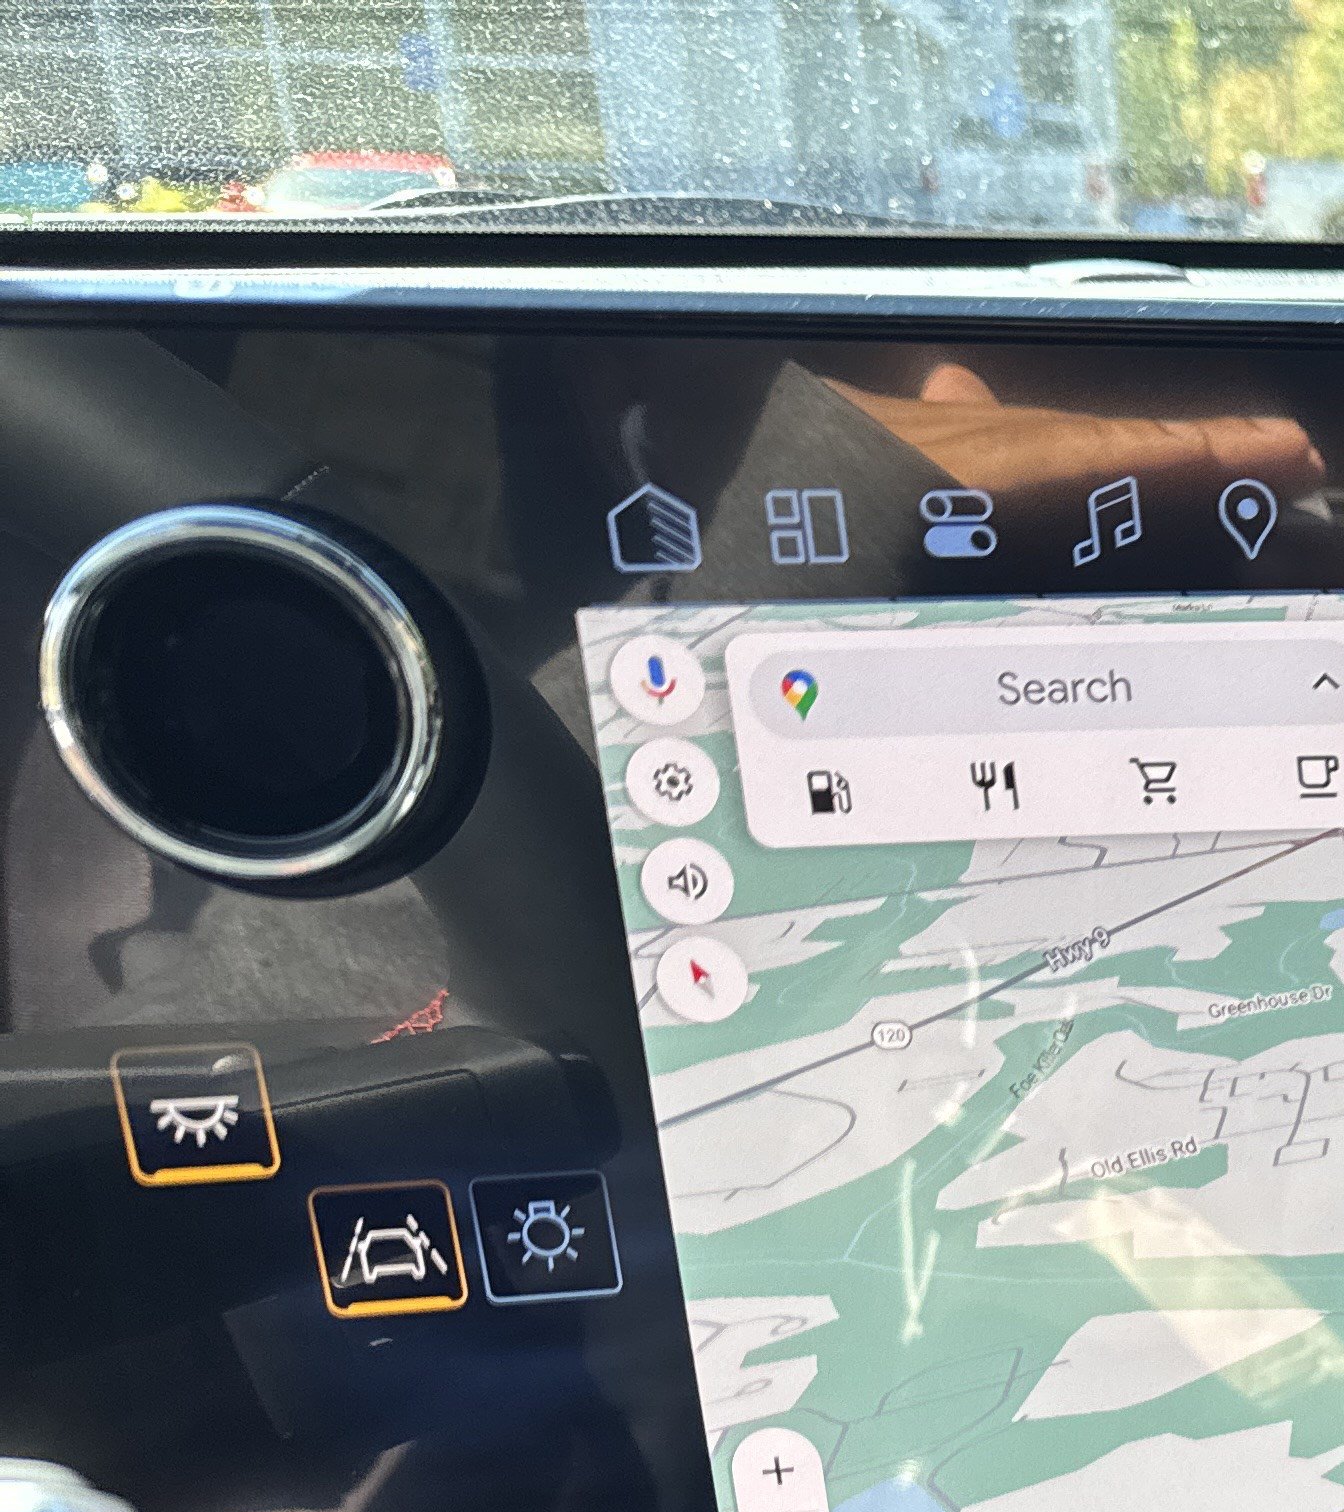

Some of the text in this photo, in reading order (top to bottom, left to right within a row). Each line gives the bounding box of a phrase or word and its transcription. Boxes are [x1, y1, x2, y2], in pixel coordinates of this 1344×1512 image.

[997, 671, 1133, 706] Search
[1043, 926, 1110, 973] Hwy 9
[1208, 986, 1333, 1019] Greenhouse Dr
[878, 1028, 905, 1043] 120
[1091, 1138, 1197, 1178] Old Ellis Rd
